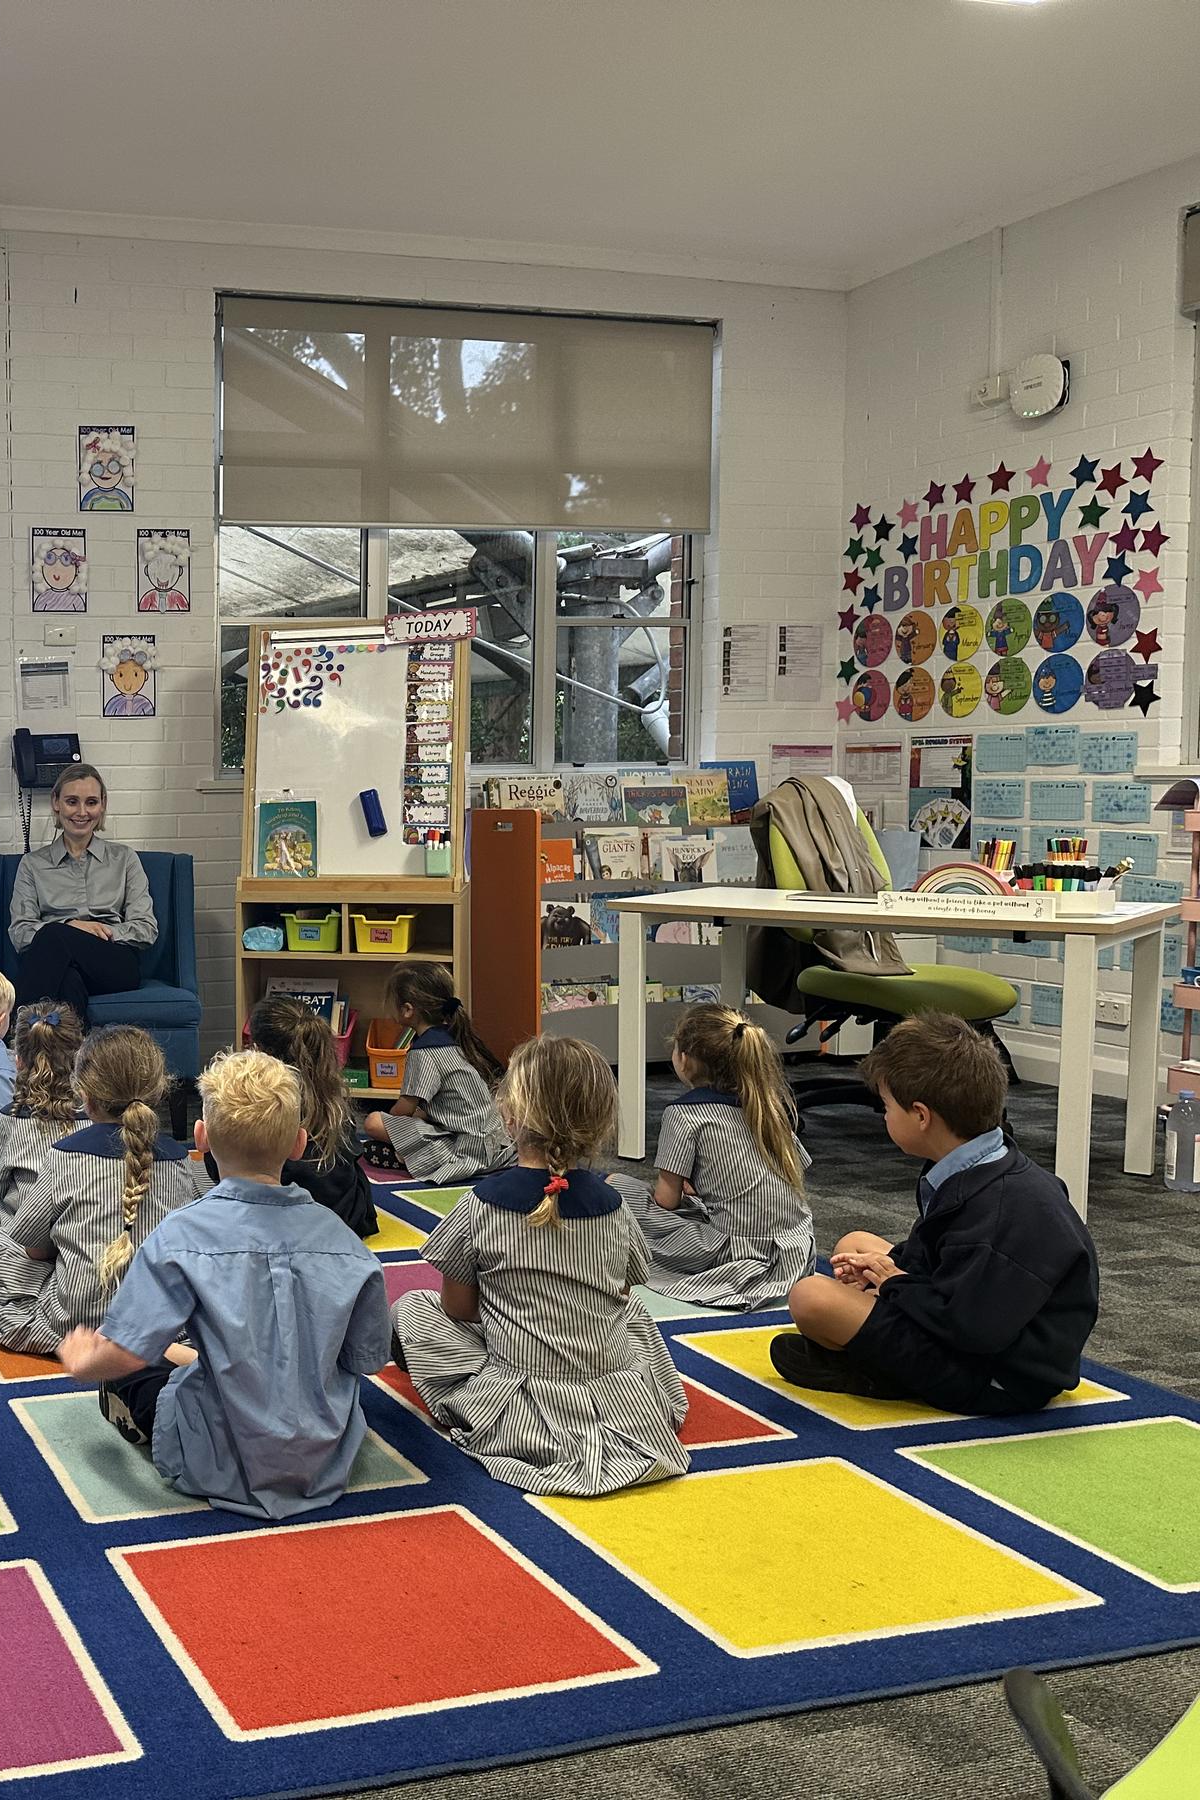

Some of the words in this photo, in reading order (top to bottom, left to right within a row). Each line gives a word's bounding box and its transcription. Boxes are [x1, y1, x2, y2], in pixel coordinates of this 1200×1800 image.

[919, 488, 1076, 561] HAPPY
[883, 532, 1109, 612] BIRTHDAY
[406, 618, 452, 634] TODAY
[729, 767, 751, 776] RAIN
[508, 783, 556, 801] Reggie
[602, 843, 635, 853] GIANTS
[545, 863, 571, 873] Alpacas
[295, 995, 331, 1005] BAT
